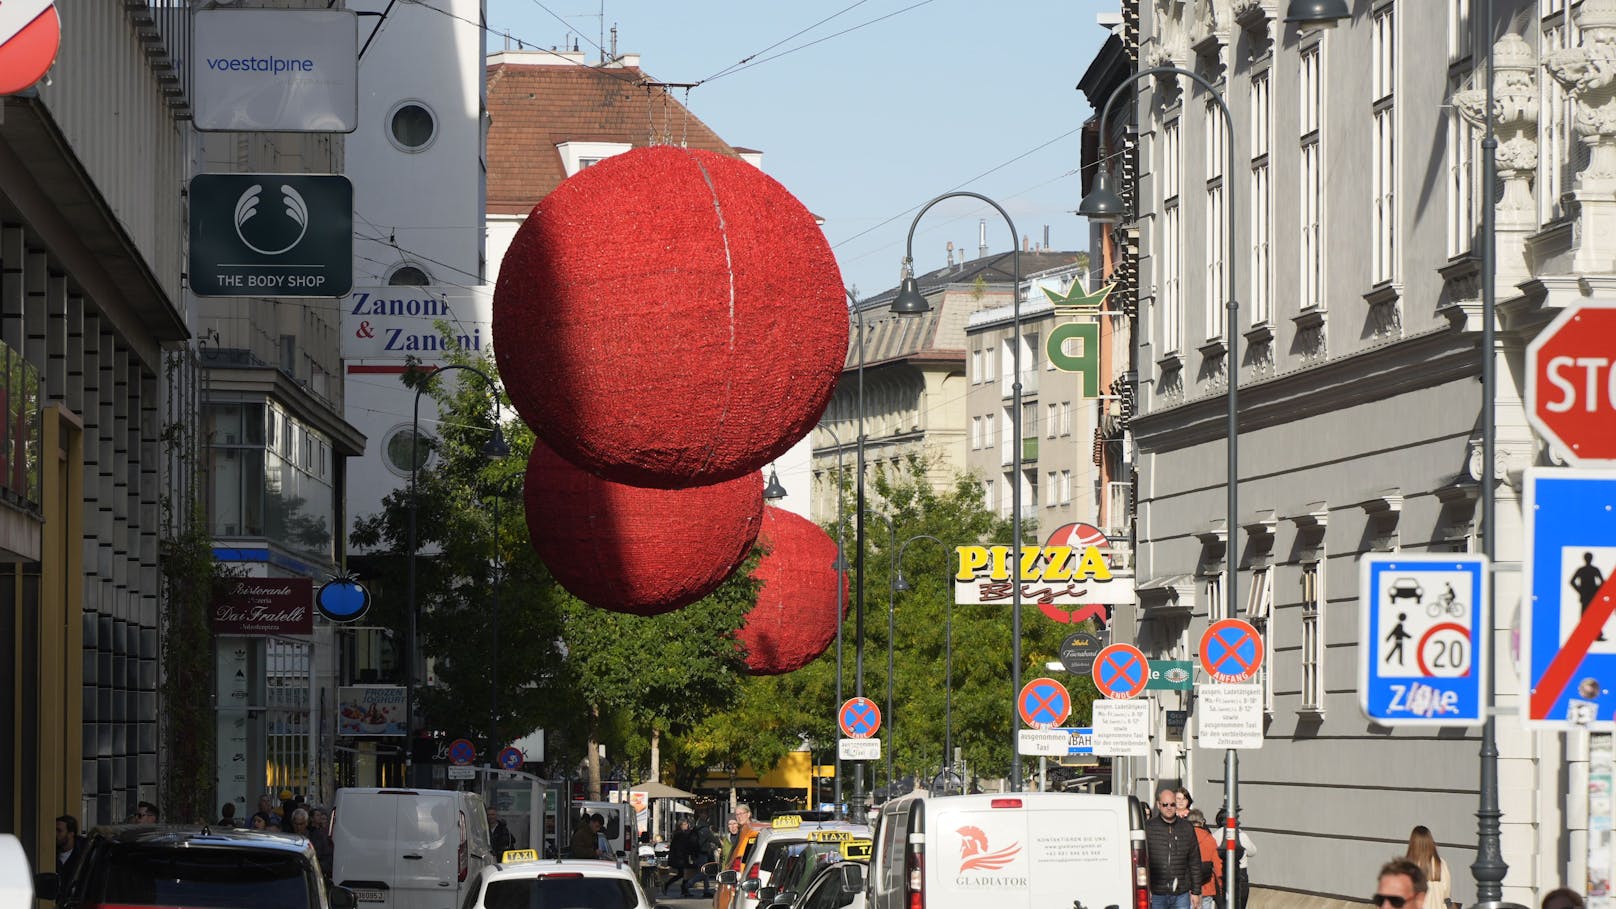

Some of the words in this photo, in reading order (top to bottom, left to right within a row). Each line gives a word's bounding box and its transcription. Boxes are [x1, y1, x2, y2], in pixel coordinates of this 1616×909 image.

[207, 56, 313, 75] voestalpine
[217, 275, 243, 287] THE
[248, 275, 284, 287] BODY
[287, 275, 325, 287] SHOP
[352, 293, 448, 316] Zanoni
[355, 320, 375, 339] &
[1545, 355, 1616, 413] ST
[955, 545, 1114, 582] PIZZA
[1433, 640, 1464, 668] 20
[1213, 671, 1249, 683] ANFANG
[1111, 691, 1128, 699] ENDE
[1020, 733, 1066, 741] ausgenommen
[1037, 743, 1049, 751] Taxi
[507, 851, 533, 860] TAXI
[956, 876, 1027, 886] GLADIATOR
